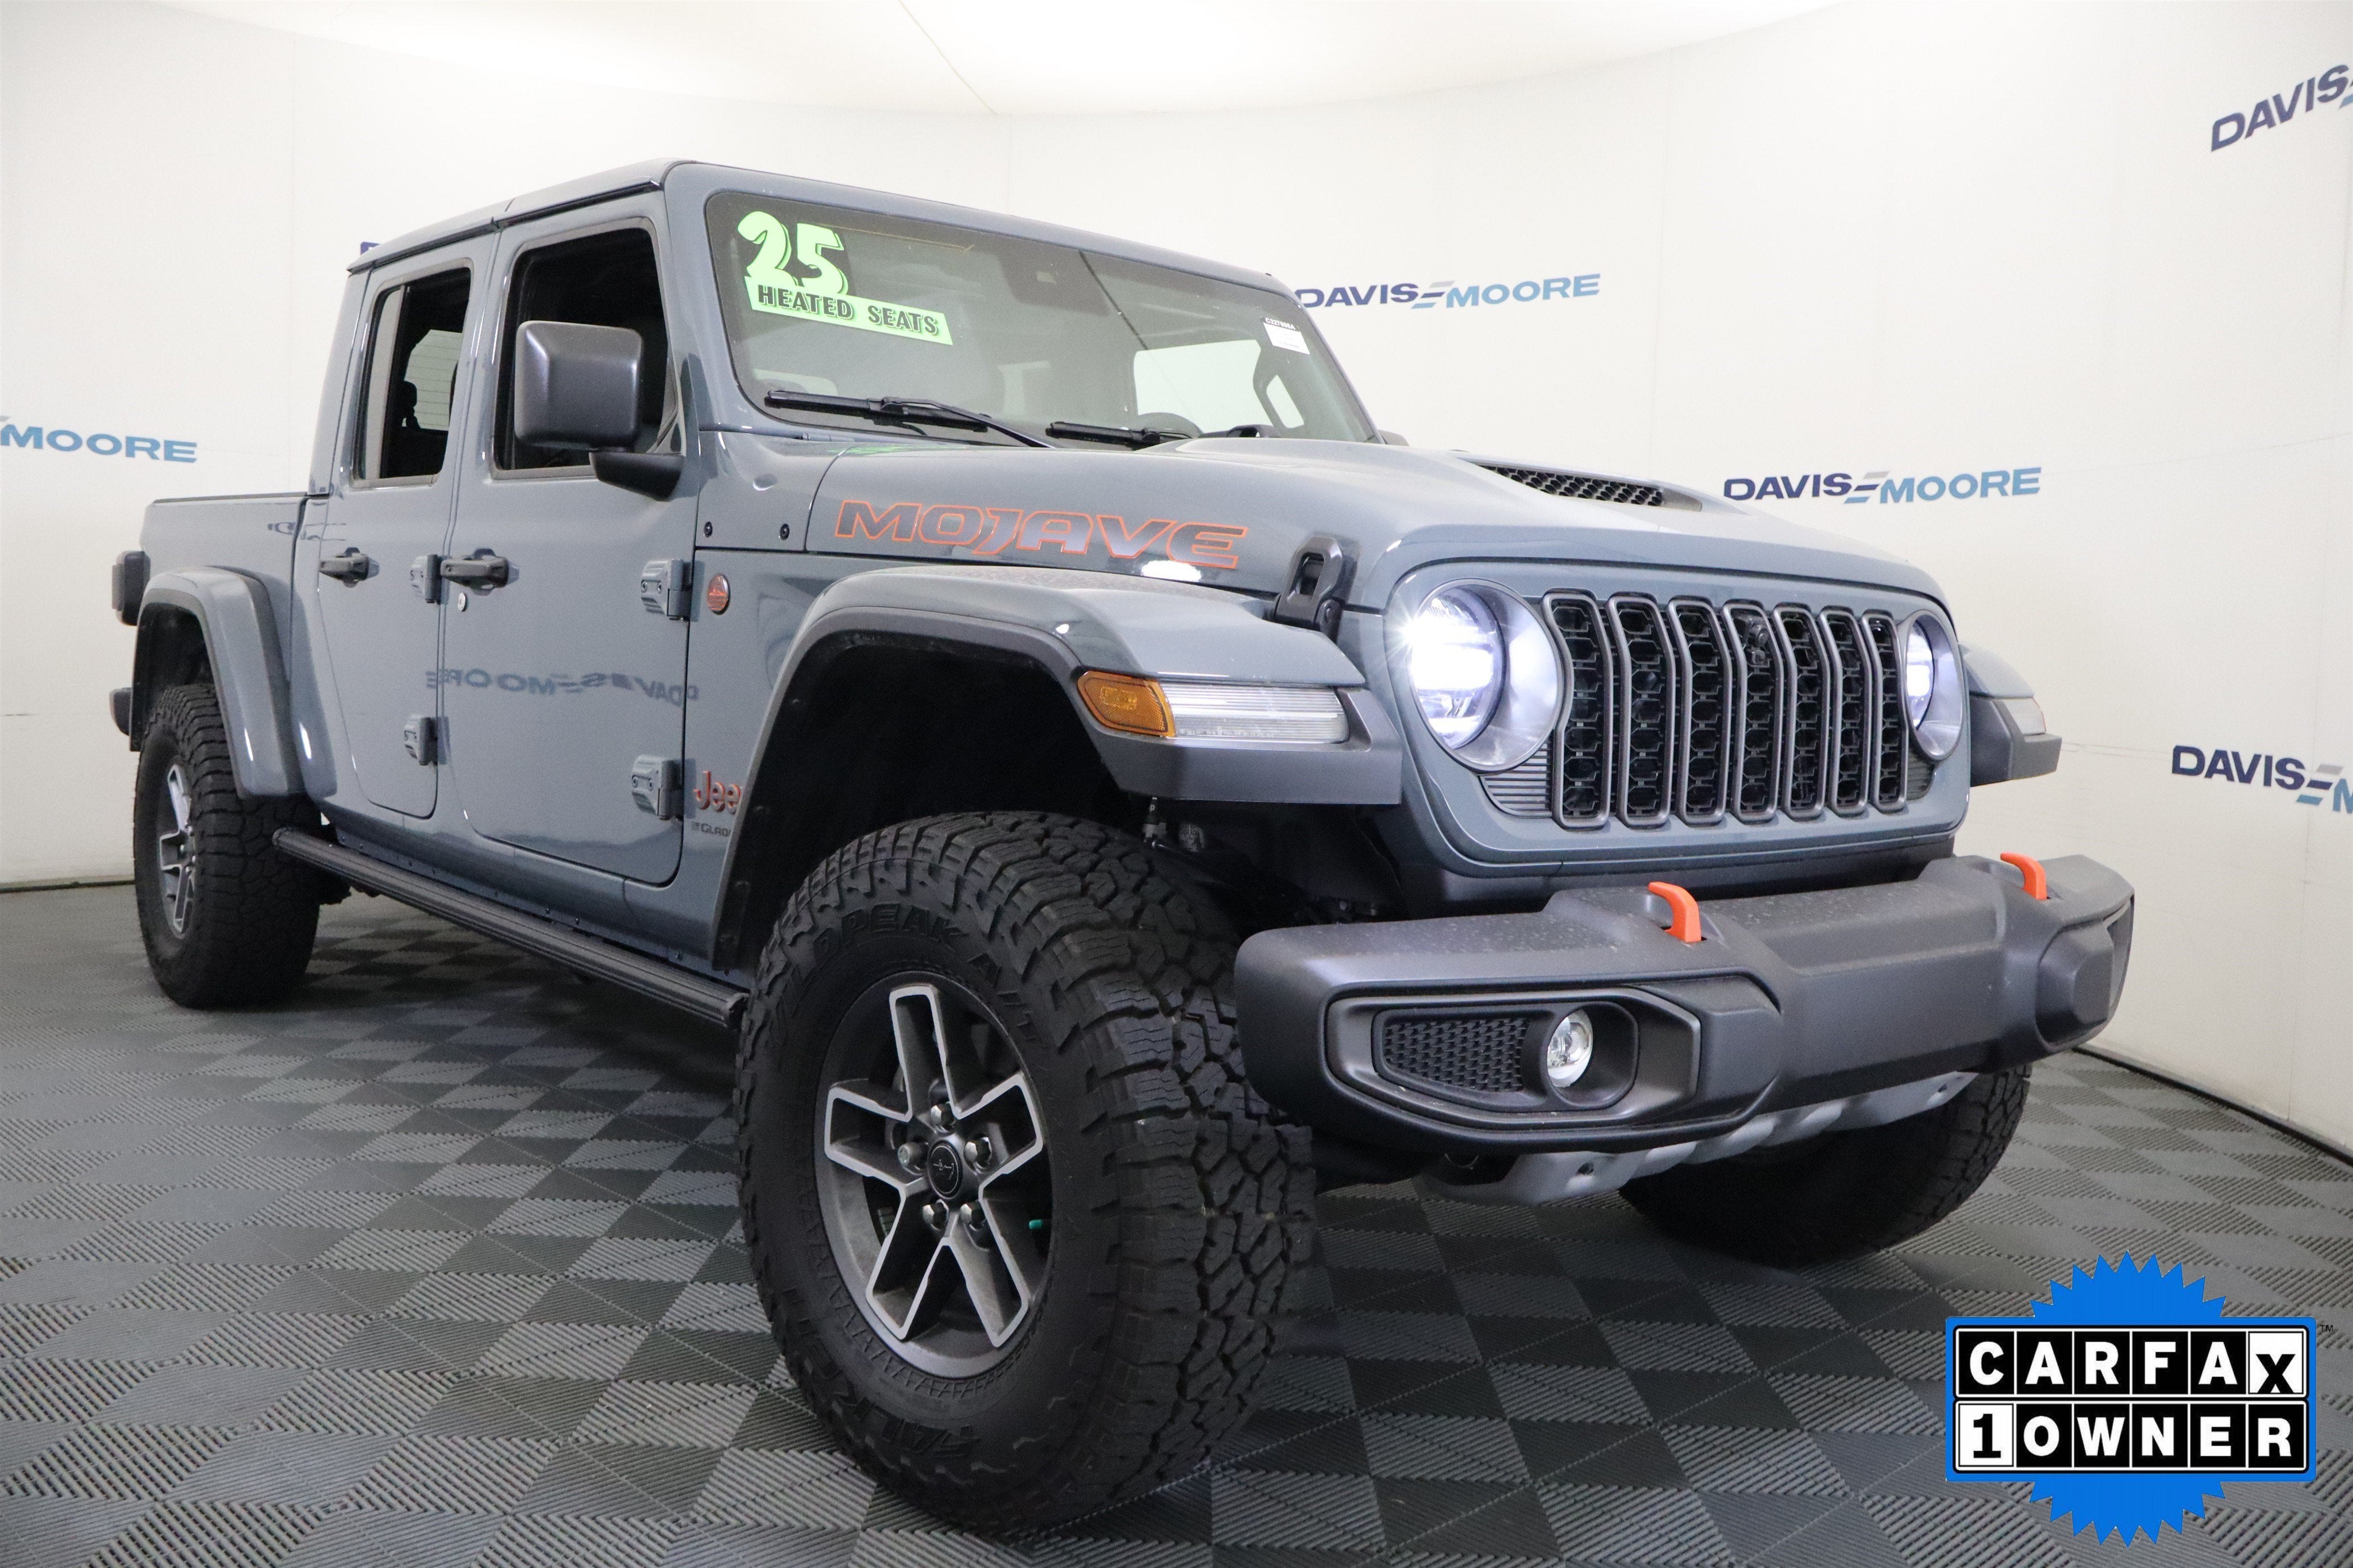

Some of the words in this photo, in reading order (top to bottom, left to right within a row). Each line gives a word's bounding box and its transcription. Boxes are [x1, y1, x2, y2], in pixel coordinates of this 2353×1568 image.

[2211, 64, 2350, 152] DAVIS
[737, 210, 848, 295] 25
[758, 284, 854, 320] HEATED
[867, 304, 938, 336] SEATS
[1295, 283, 1419, 308] DAVIS
[1445, 273, 1601, 308] MOORE
[0, 424, 198, 464] MOORE
[1723, 472, 1853, 501] DAVIS
[1879, 466, 2042, 504] MOORE
[835, 500, 1249, 569] MOJAVE
[2171, 744, 2306, 791] DAVIS
[693, 770, 743, 816] Jee
